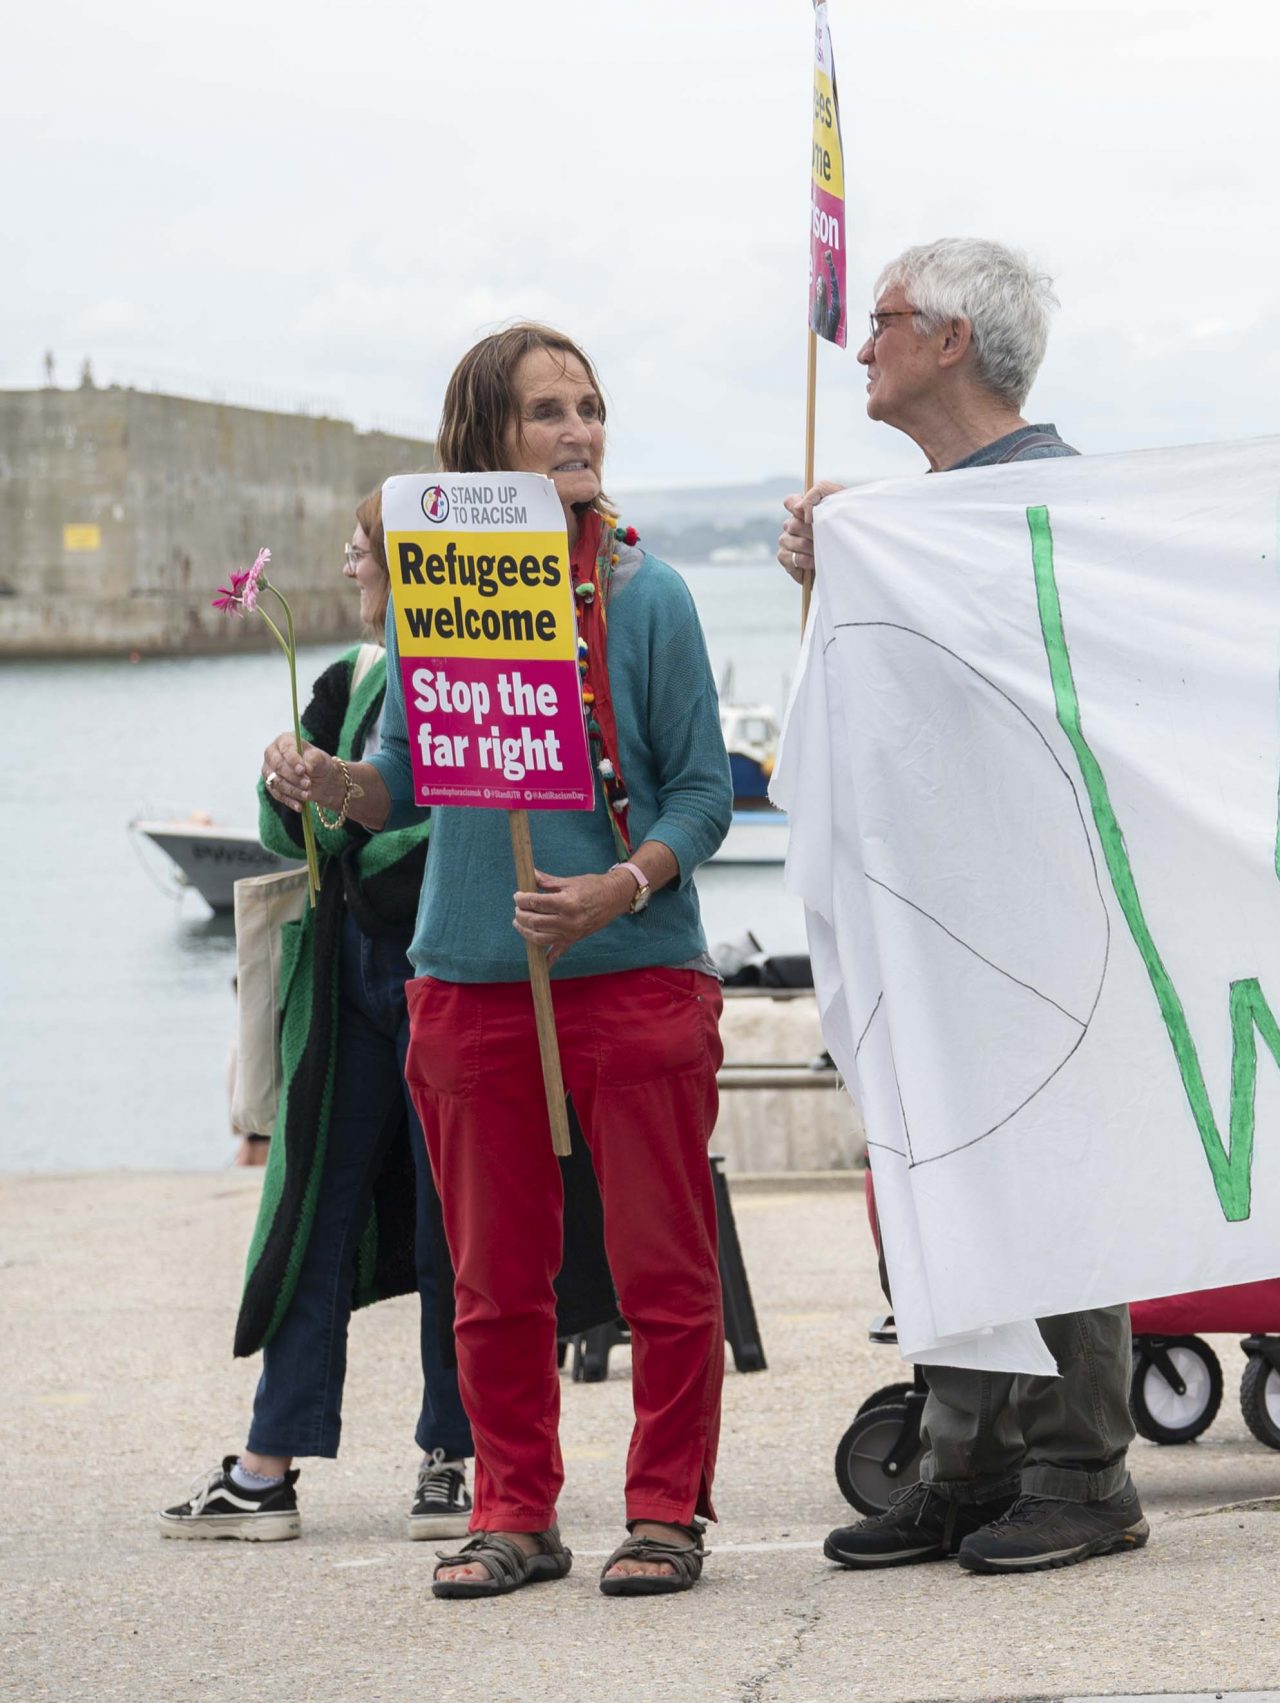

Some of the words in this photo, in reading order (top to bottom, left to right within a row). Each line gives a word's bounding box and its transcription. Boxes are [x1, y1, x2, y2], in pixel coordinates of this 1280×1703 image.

[451, 486, 494, 504] STAND
[497, 486, 517, 504] UP
[452, 506, 468, 524] TO
[471, 506, 527, 524] RACISM
[398, 542, 561, 597] Refugees
[404, 597, 556, 641] welcome
[412, 668, 490, 725] Stop
[497, 671, 559, 716] the
[417, 722, 469, 767] far
[478, 725, 563, 781] right
